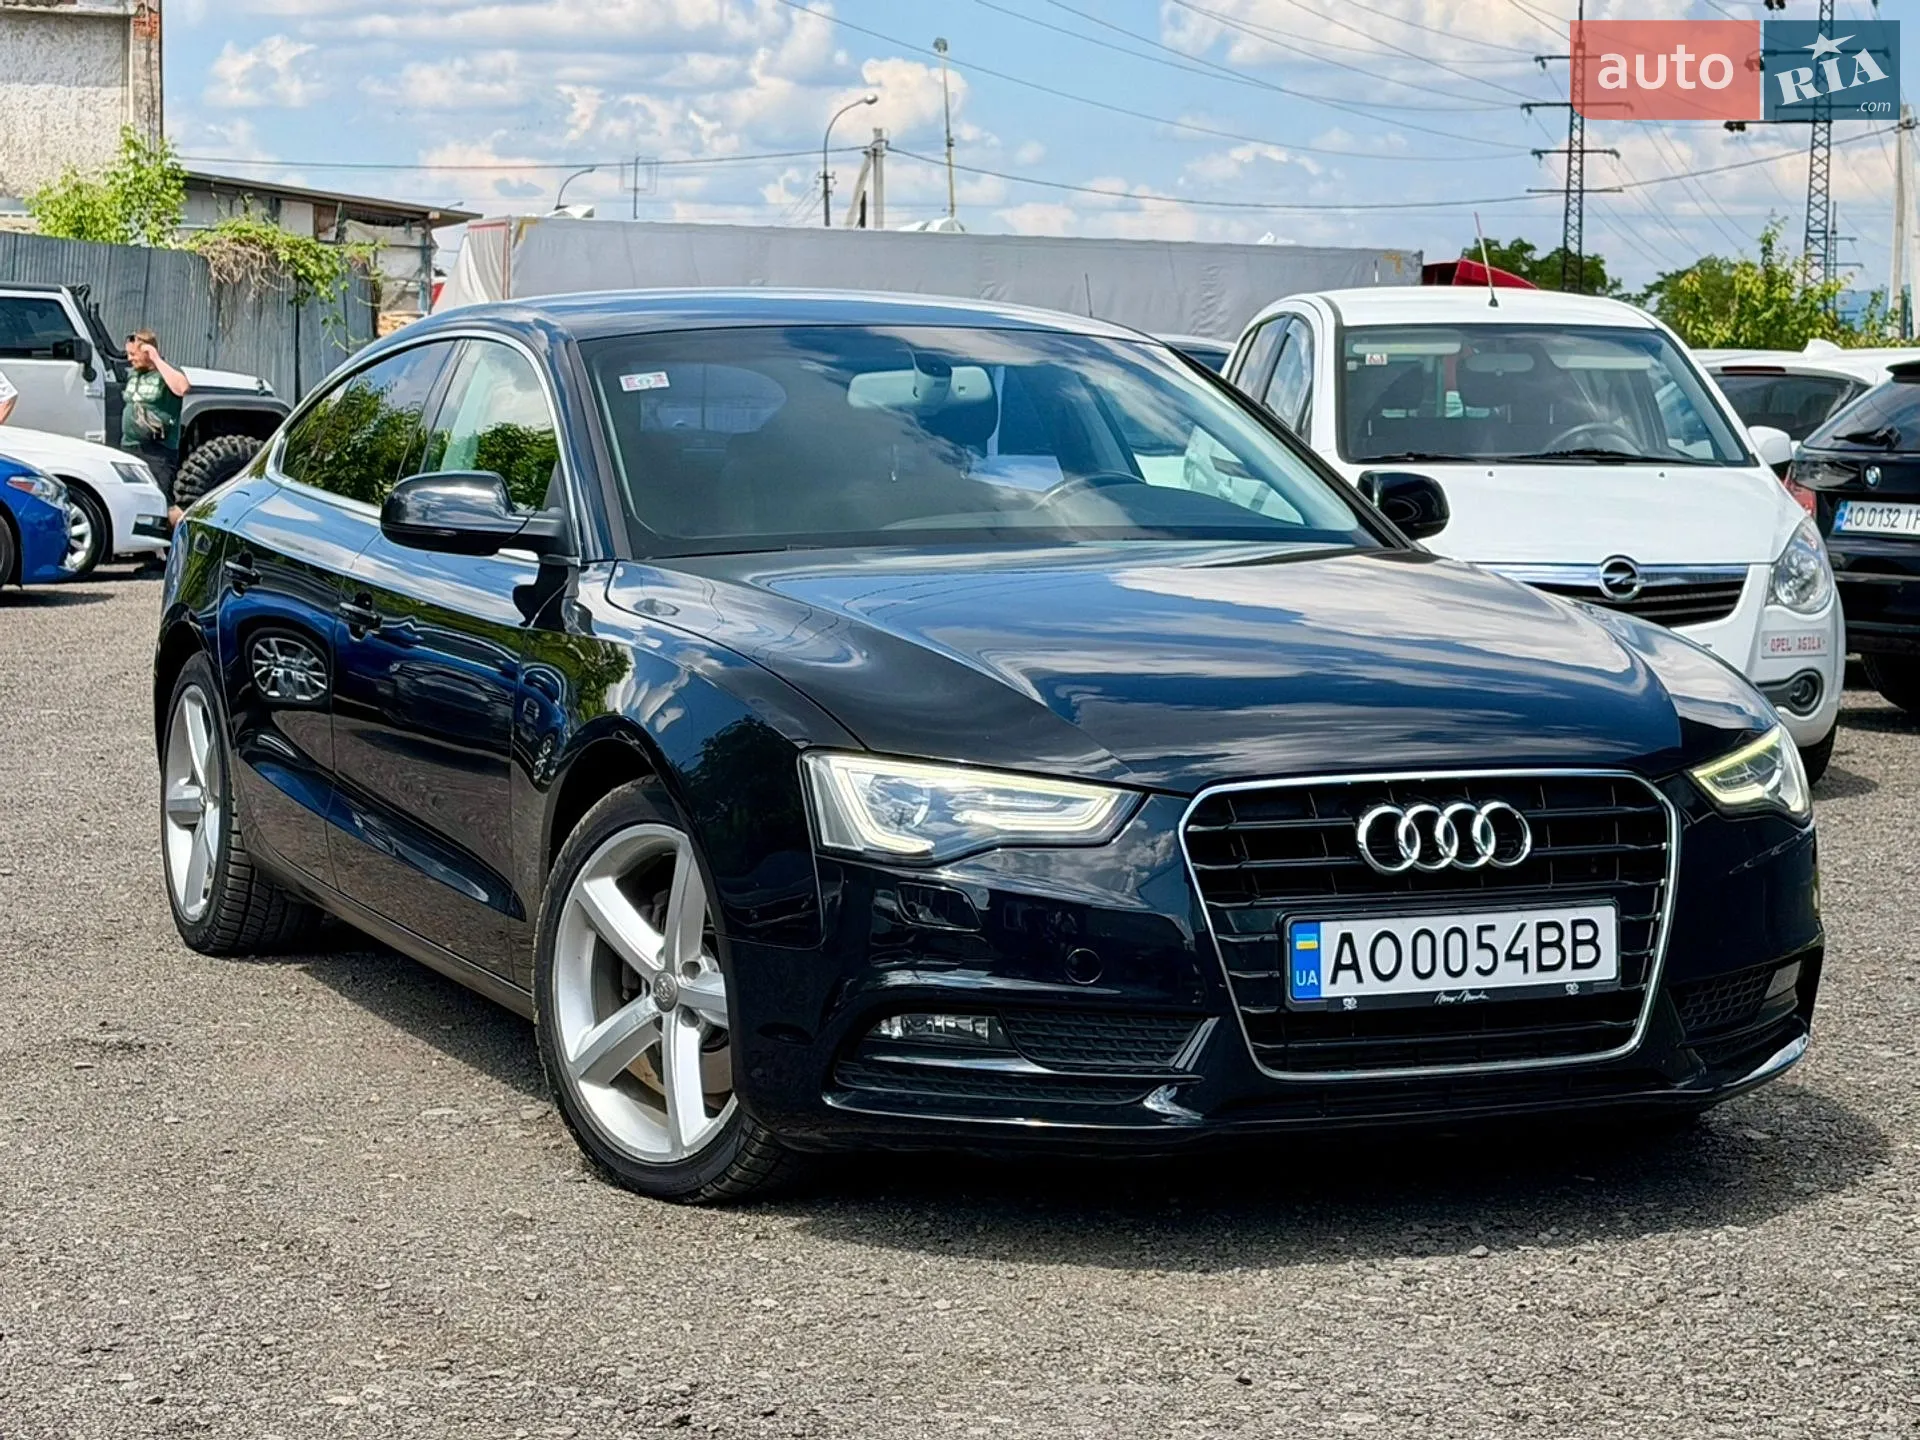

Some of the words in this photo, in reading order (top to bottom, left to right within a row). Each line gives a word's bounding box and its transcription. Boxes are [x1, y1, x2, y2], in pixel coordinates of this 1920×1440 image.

[1844, 507, 1865, 527] AO
[1867, 507, 1901, 528] 0132
[1771, 638, 1792, 651] OPEL
[1296, 970, 1318, 986] UA
